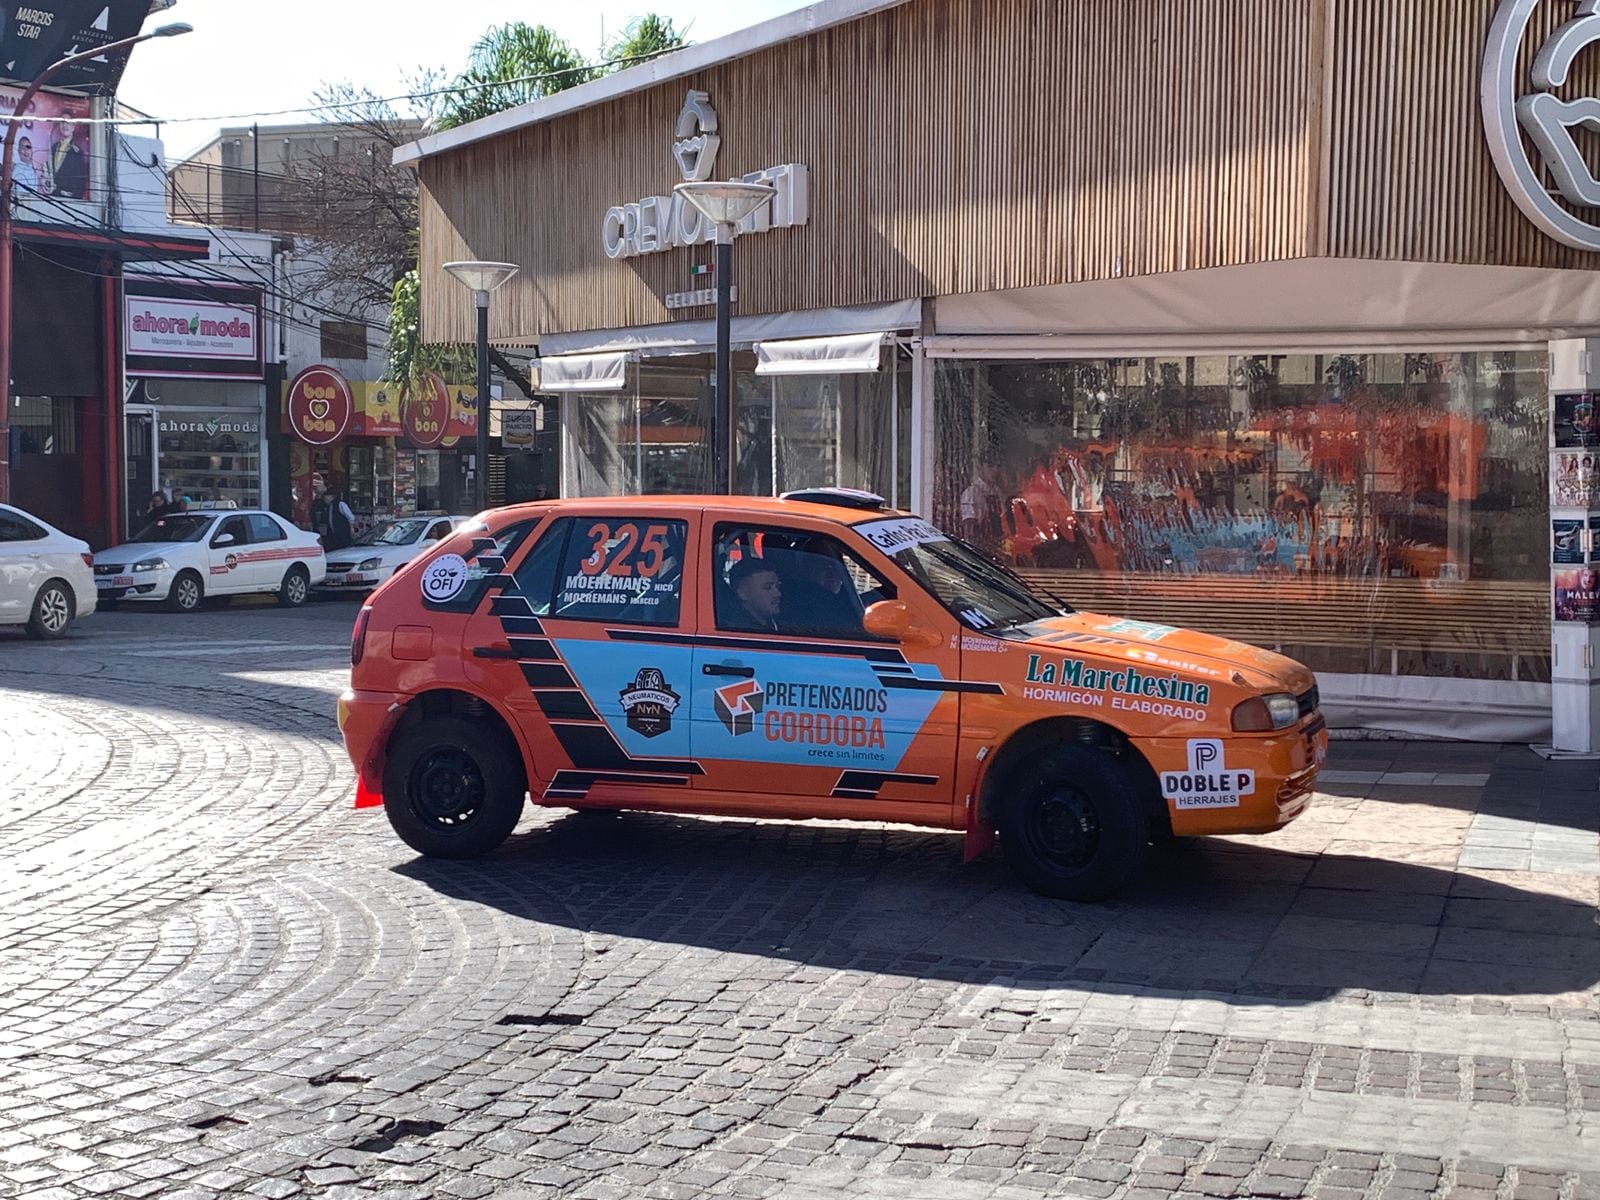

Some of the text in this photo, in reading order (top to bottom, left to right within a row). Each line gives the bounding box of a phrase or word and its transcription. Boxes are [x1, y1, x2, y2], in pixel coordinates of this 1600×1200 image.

[15, 7, 54, 26] MARCOS
[17, 24, 41, 40] STAR
[132, 311, 251, 338] ahora moda
[303, 382, 336, 399] bon
[160, 420, 258, 433] ahora moda
[303, 415, 336, 432] bon
[414, 416, 438, 432] bon
[506, 414, 532, 423] SUPER
[867, 528, 913, 548] Carlos
[581, 523, 668, 577] 325
[430, 578, 453, 590] OFI
[565, 576, 673, 592] MOEREMANS NICO
[564, 592, 627, 604] MOEREMANS
[1025, 654, 1210, 705] La Marchesina
[628, 692, 670, 703] NEUMATICOS
[765, 682, 888, 713] PRETENSADOS
[1023, 687, 1207, 722] HORMIGÓN ELABORADO
[765, 710, 886, 749] CORDOBA
[808, 748, 834, 758] crece
[836, 750, 850, 759] sin
[1166, 774, 1250, 793] DOBLE P
[1179, 794, 1237, 806] HERRAJES
